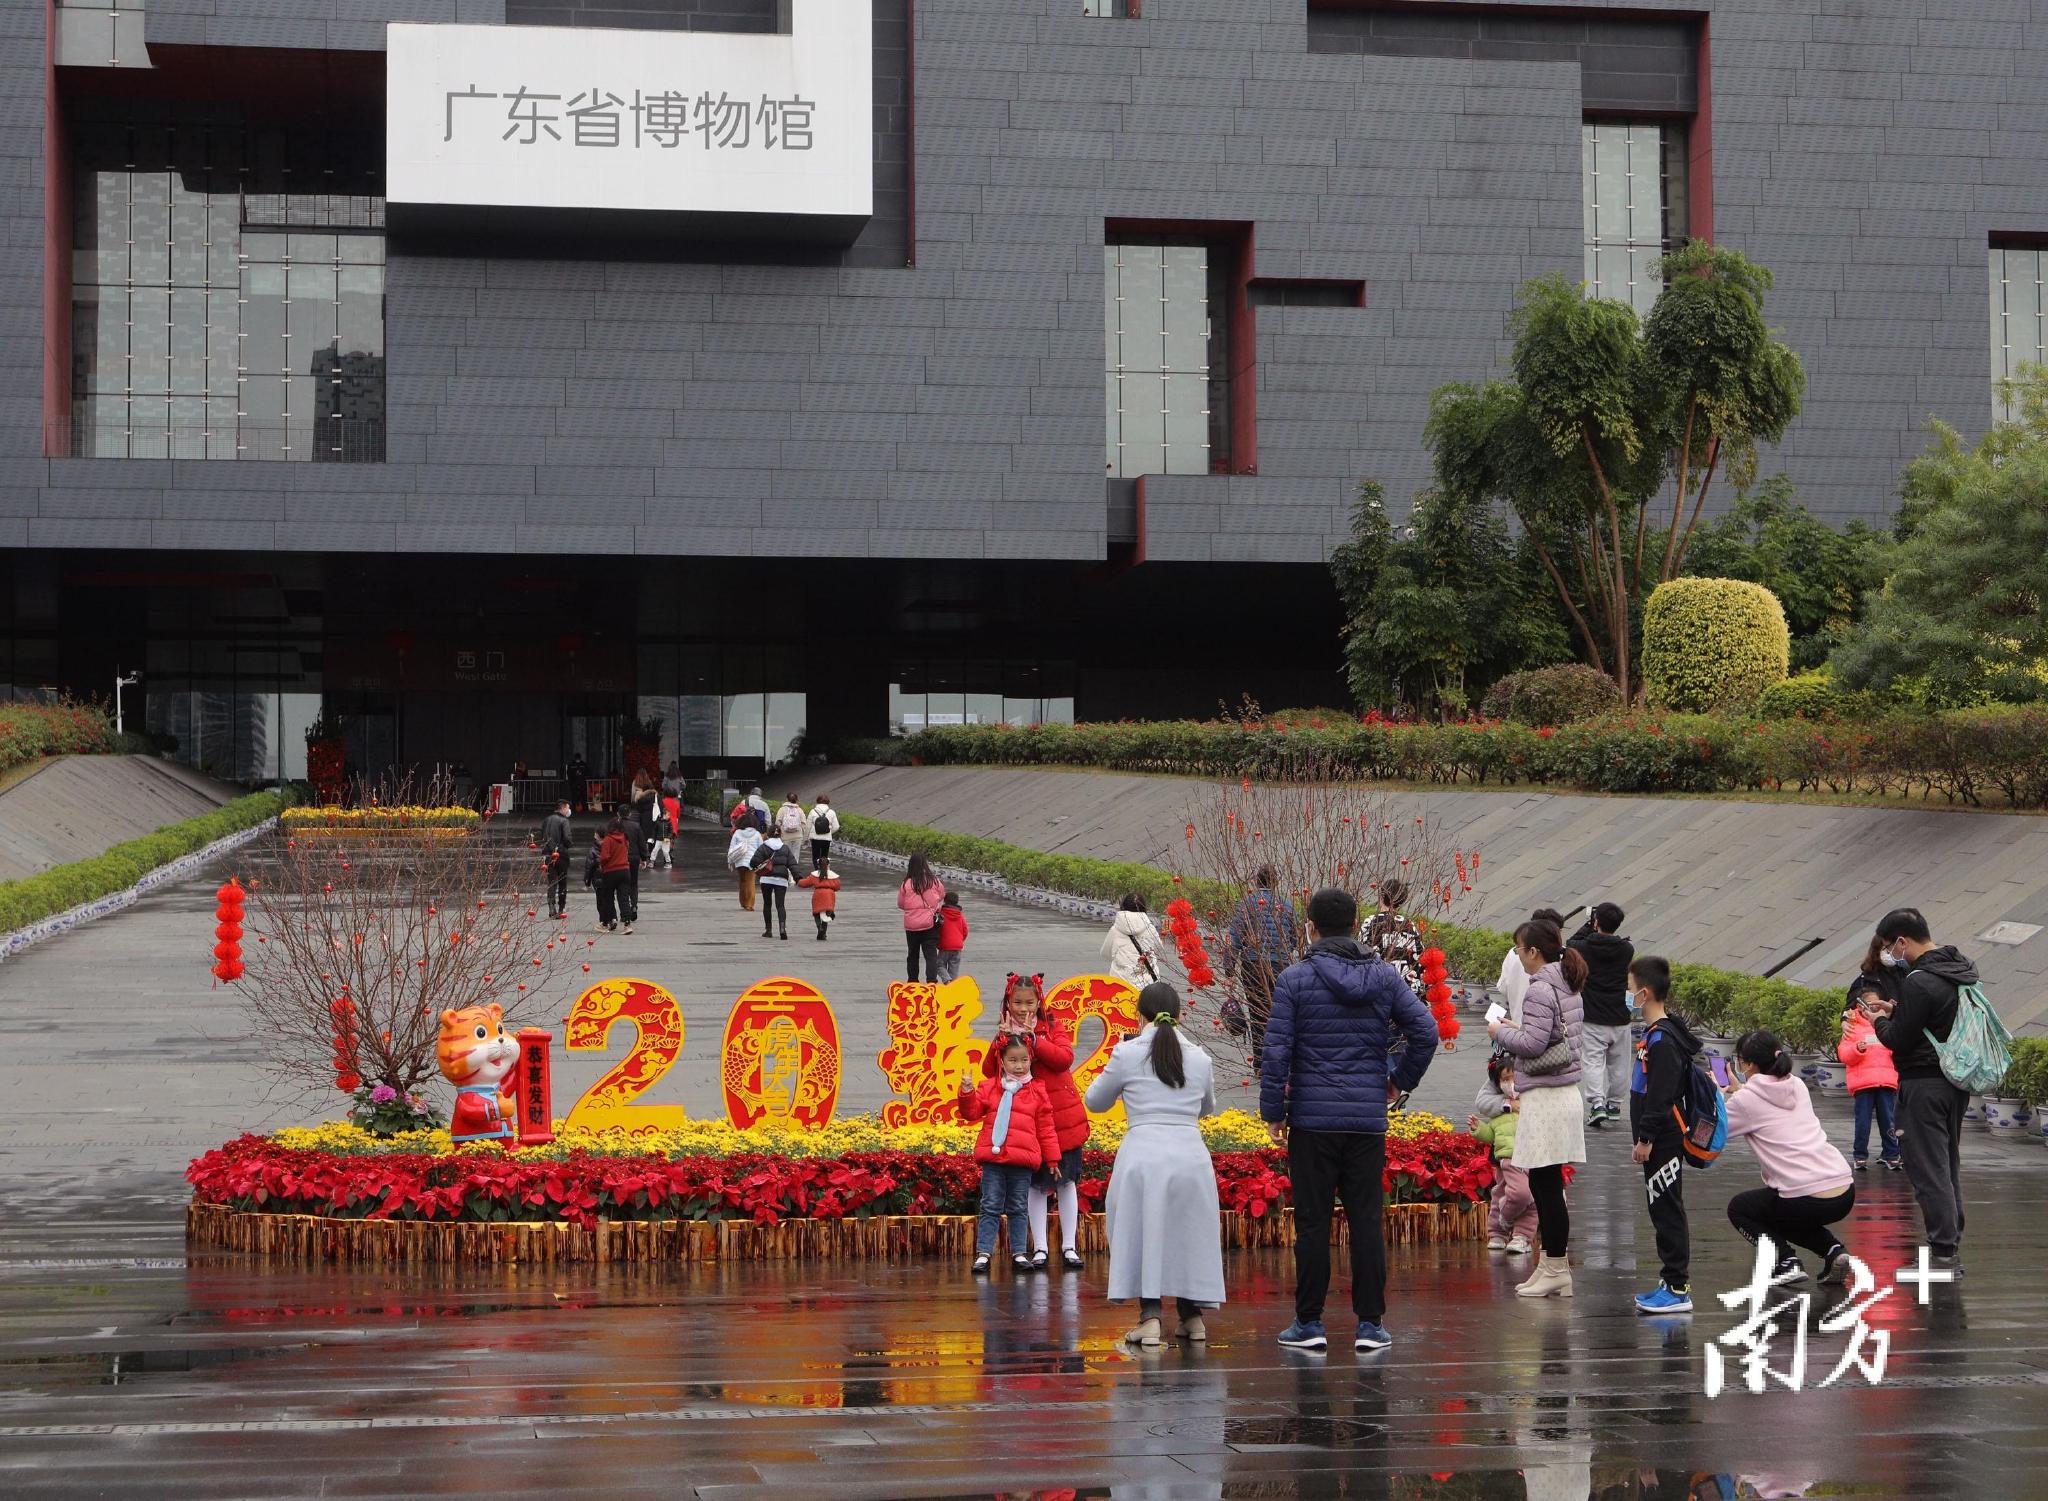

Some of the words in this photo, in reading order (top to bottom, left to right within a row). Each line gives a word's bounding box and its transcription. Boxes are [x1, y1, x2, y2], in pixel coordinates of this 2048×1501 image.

[443, 83, 816, 151] 广东省博物馆
[456, 650, 505, 669] 西门
[527, 1044, 544, 1126] 恭喜发财
[1645, 1156, 1680, 1205] XTEP
